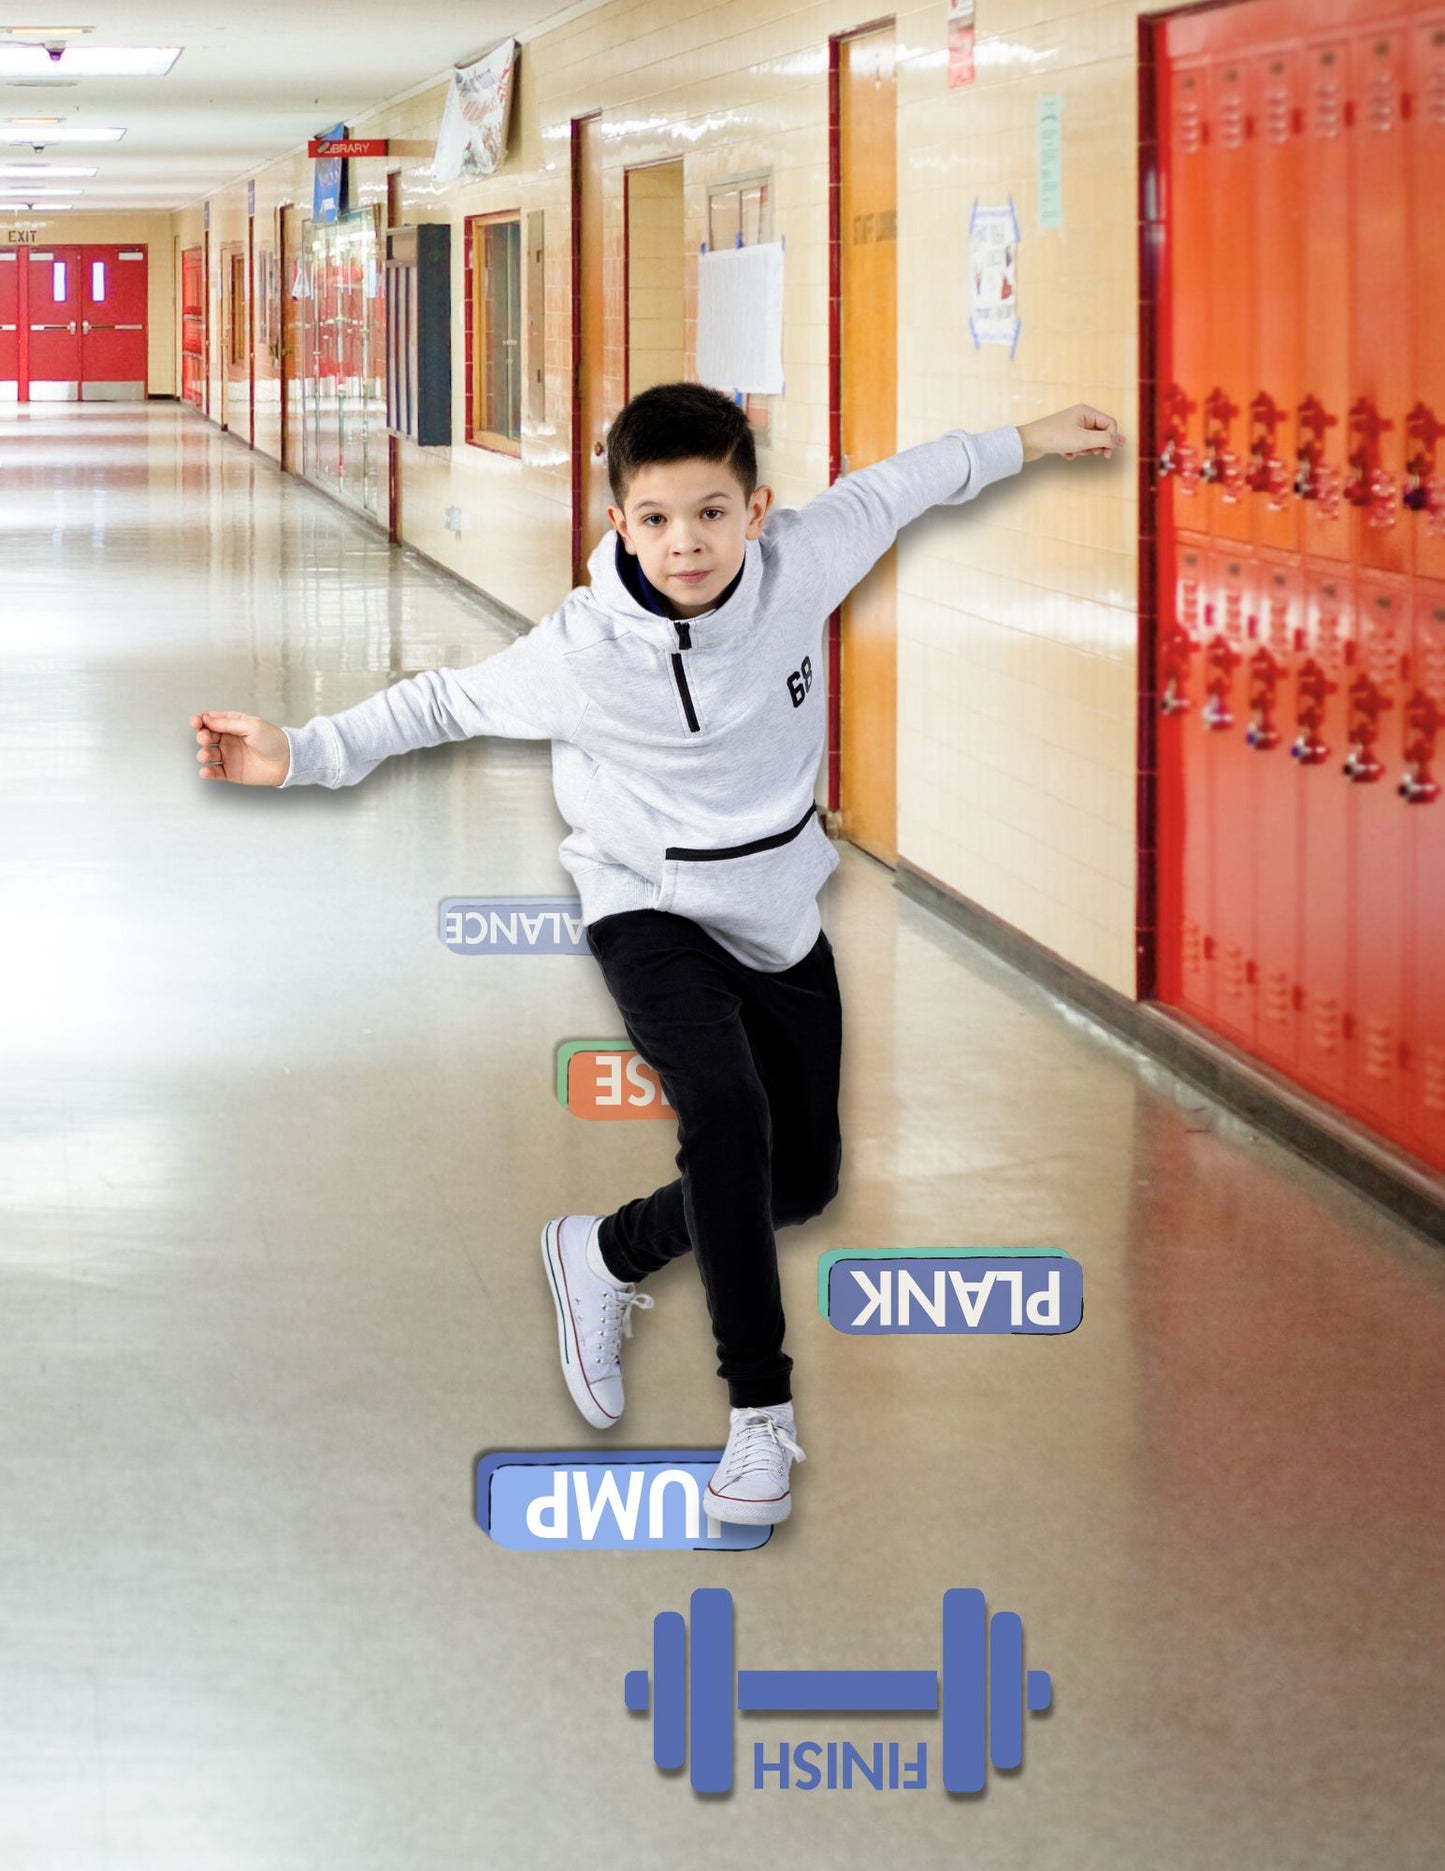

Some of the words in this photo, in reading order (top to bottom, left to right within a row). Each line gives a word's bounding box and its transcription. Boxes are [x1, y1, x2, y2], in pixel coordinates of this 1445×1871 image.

[8, 230, 38, 243] EXIT
[786, 655, 813, 708] 68
[446, 911, 585, 945] ALANCE
[595, 1054, 671, 1107] SE
[850, 1269, 1060, 1328] PLANK
[525, 1469, 722, 1541] UMP
[753, 1741, 927, 1791] FINISH
